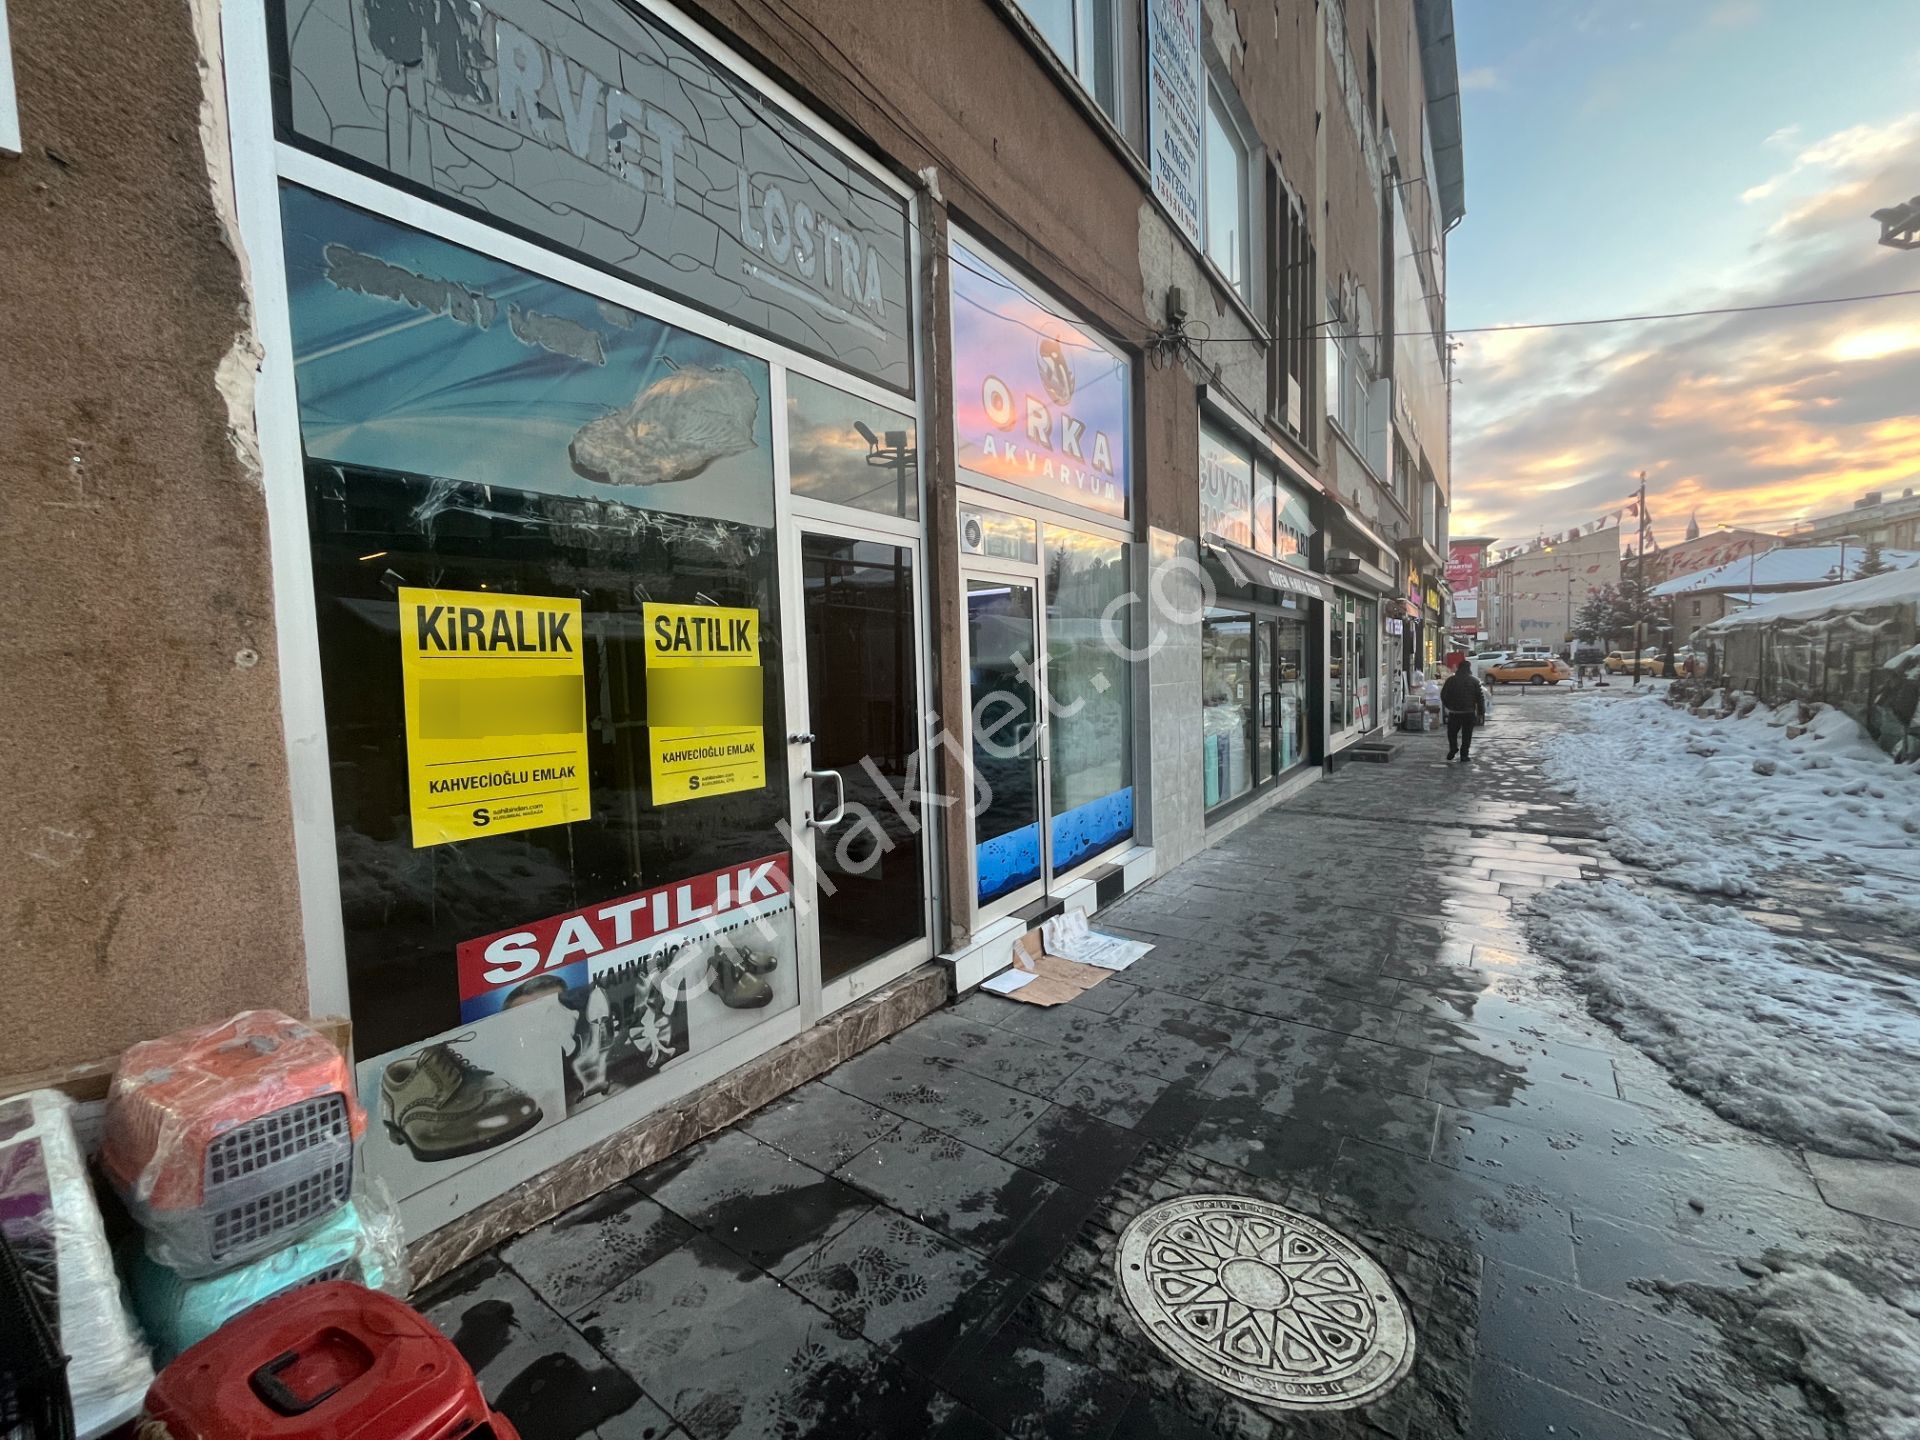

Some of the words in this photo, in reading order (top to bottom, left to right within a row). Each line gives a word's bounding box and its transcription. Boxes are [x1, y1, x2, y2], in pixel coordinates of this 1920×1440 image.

[734, 162, 889, 318] LOSTRA
[981, 375, 1114, 476] ORKA
[983, 433, 1117, 500] AKVARYUM
[654, 614, 752, 652] SATILIK
[662, 744, 725, 764] KAHVECİOĞLU
[726, 743, 755, 756] EMLAK
[429, 770, 528, 794] KAHVECİOĞLU
[532, 765, 576, 782] EMLAK
[472, 808, 491, 827] S
[492, 803, 544, 817] sahibinden.com
[483, 860, 778, 985] SATILIK
[1220, 1364, 1343, 1396] DEKORSAN
